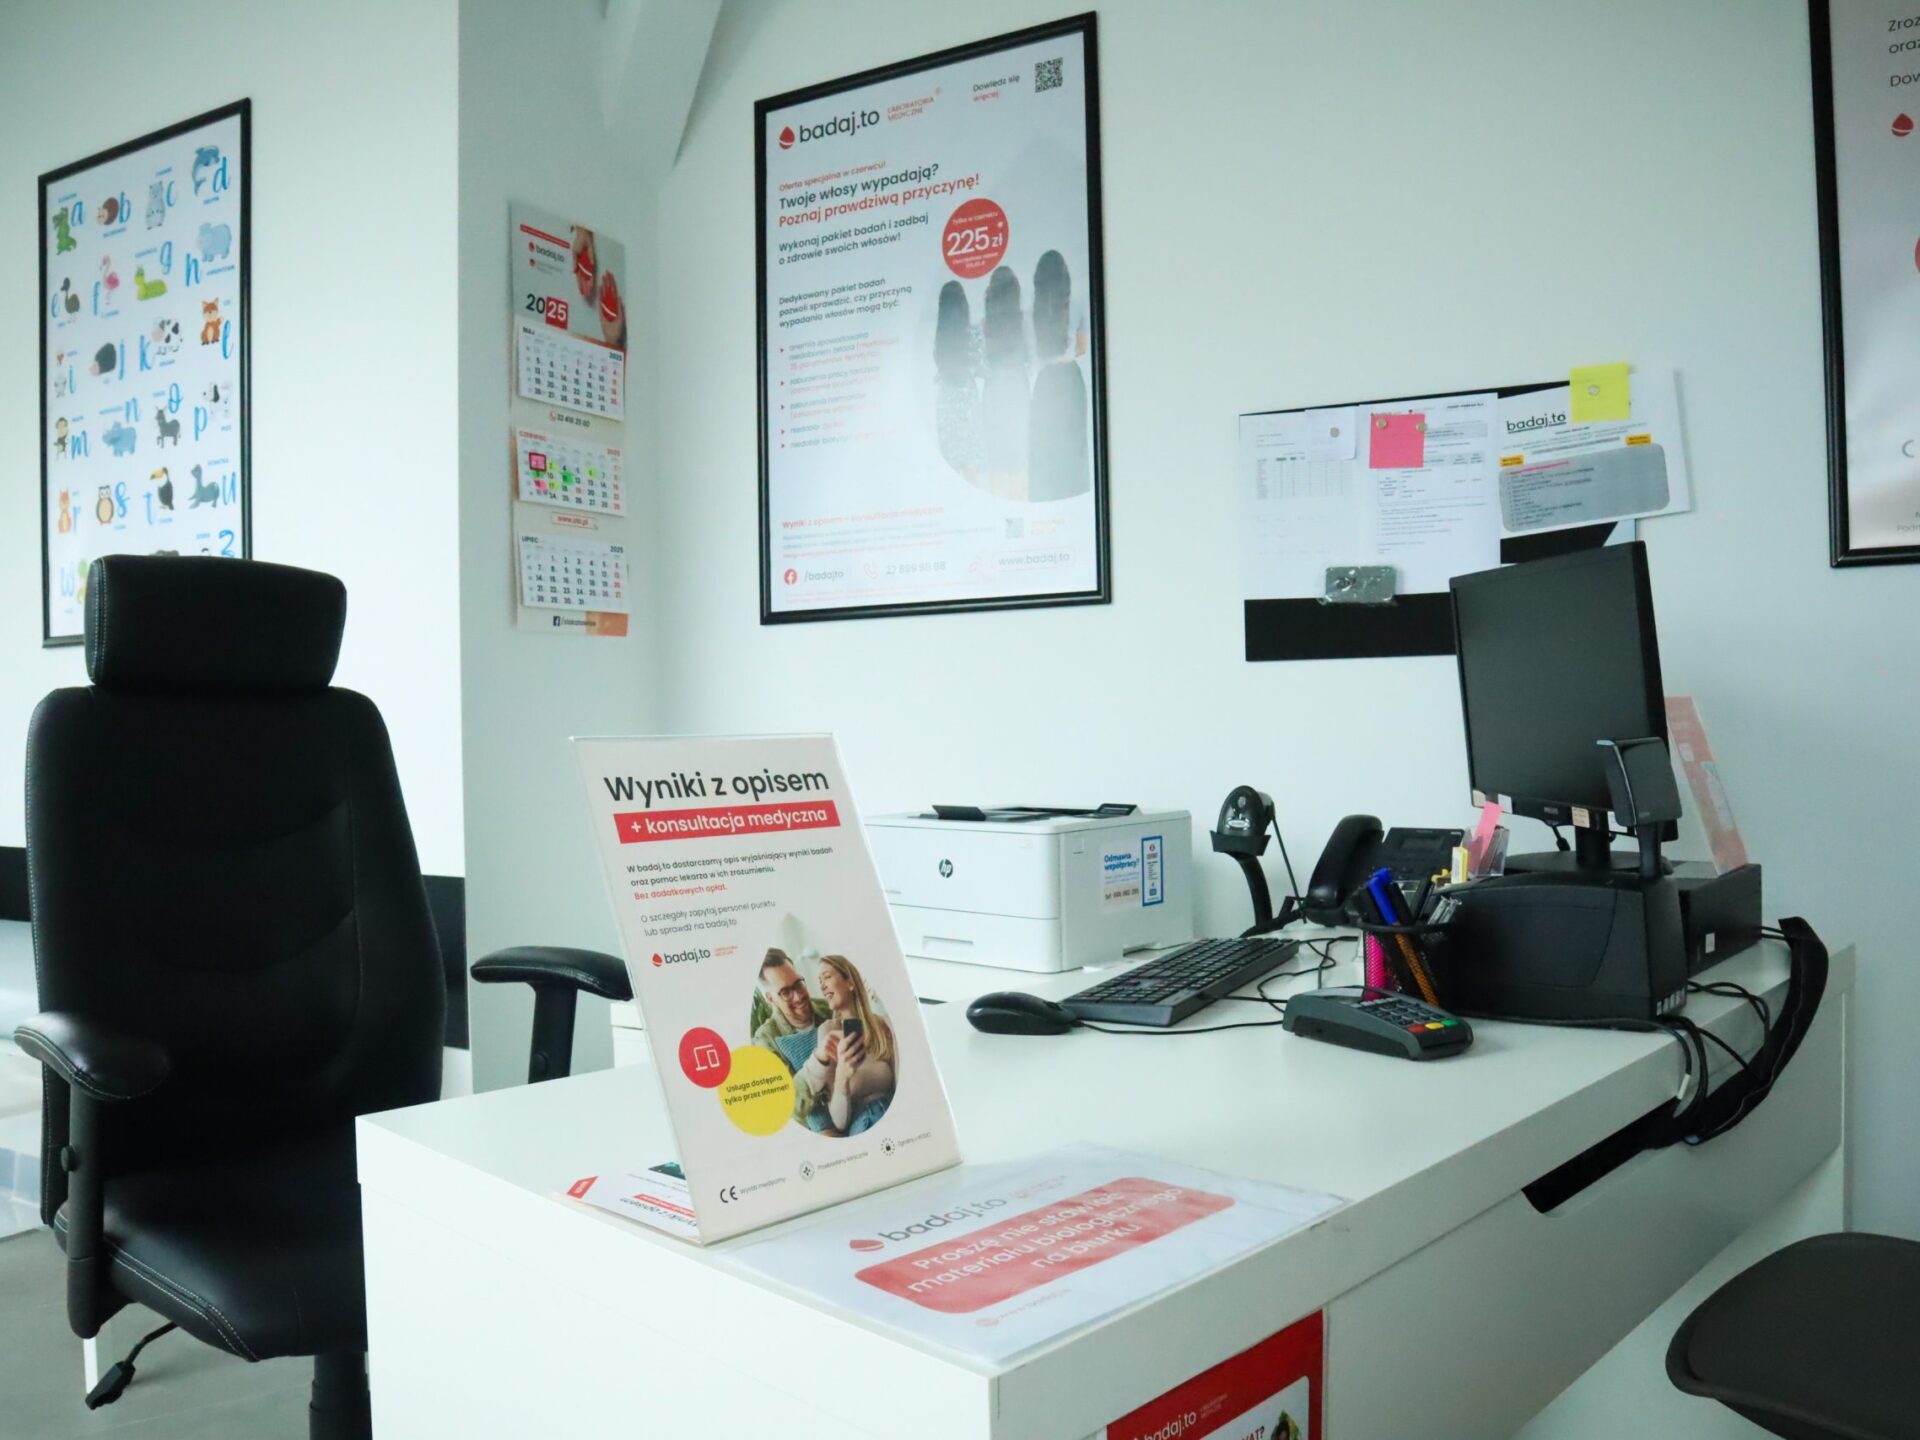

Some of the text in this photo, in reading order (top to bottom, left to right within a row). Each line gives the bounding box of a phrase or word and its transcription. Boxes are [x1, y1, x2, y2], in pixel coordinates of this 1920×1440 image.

[799, 110, 880, 142] badaj.to
[213, 156, 232, 193] d
[780, 163, 939, 210] Twoje włosy wypadają?
[779, 173, 980, 227] Poznaj prawdziwą przyczynę!
[779, 234, 820, 252] Wykonaj
[822, 229, 852, 244] pakiet
[854, 221, 887, 236] badań
[894, 212, 929, 228] zadbaj
[947, 226, 990, 256] 225
[779, 232, 901, 265] o zdrowie swoich włosów!
[830, 283, 857, 296] pakiet
[526, 293, 568, 321] 2025
[140, 335, 152, 371] k
[194, 405, 208, 442] p
[1506, 411, 1567, 432] badaj.to
[603, 768, 830, 808] Wyniki z opisem
[630, 805, 828, 834] + konsultacja medyczna
[626, 846, 833, 874] W badaj.to dostarczamy opis wyjaśniający wyniki badań
[940, 859, 953, 878] hp
[631, 879, 650, 887] oraz
[651, 875, 678, 887] pomoc
[679, 872, 708, 881] lekarza
[730, 865, 776, 877] zrozumieniu.
[634, 891, 649, 901] Bez
[650, 886, 705, 898] dodatkowych
[641, 900, 776, 923] O szczegóły zapytaj personel punktu
[644, 928, 658, 937] lub
[659, 924, 692, 936] sprawdź
[694, 922, 705, 930] na
[664, 948, 712, 964] badaj.to
[751, 1075, 783, 1087] dostępna
[720, 1185, 738, 1203] CE
[878, 1196, 1007, 1242] badaj.to
[912, 1237, 993, 1271] Proszę
[999, 1220, 1039, 1242] nie
[1031, 1222, 1142, 1270] na biurku
[907, 1242, 1036, 1295] materiału
